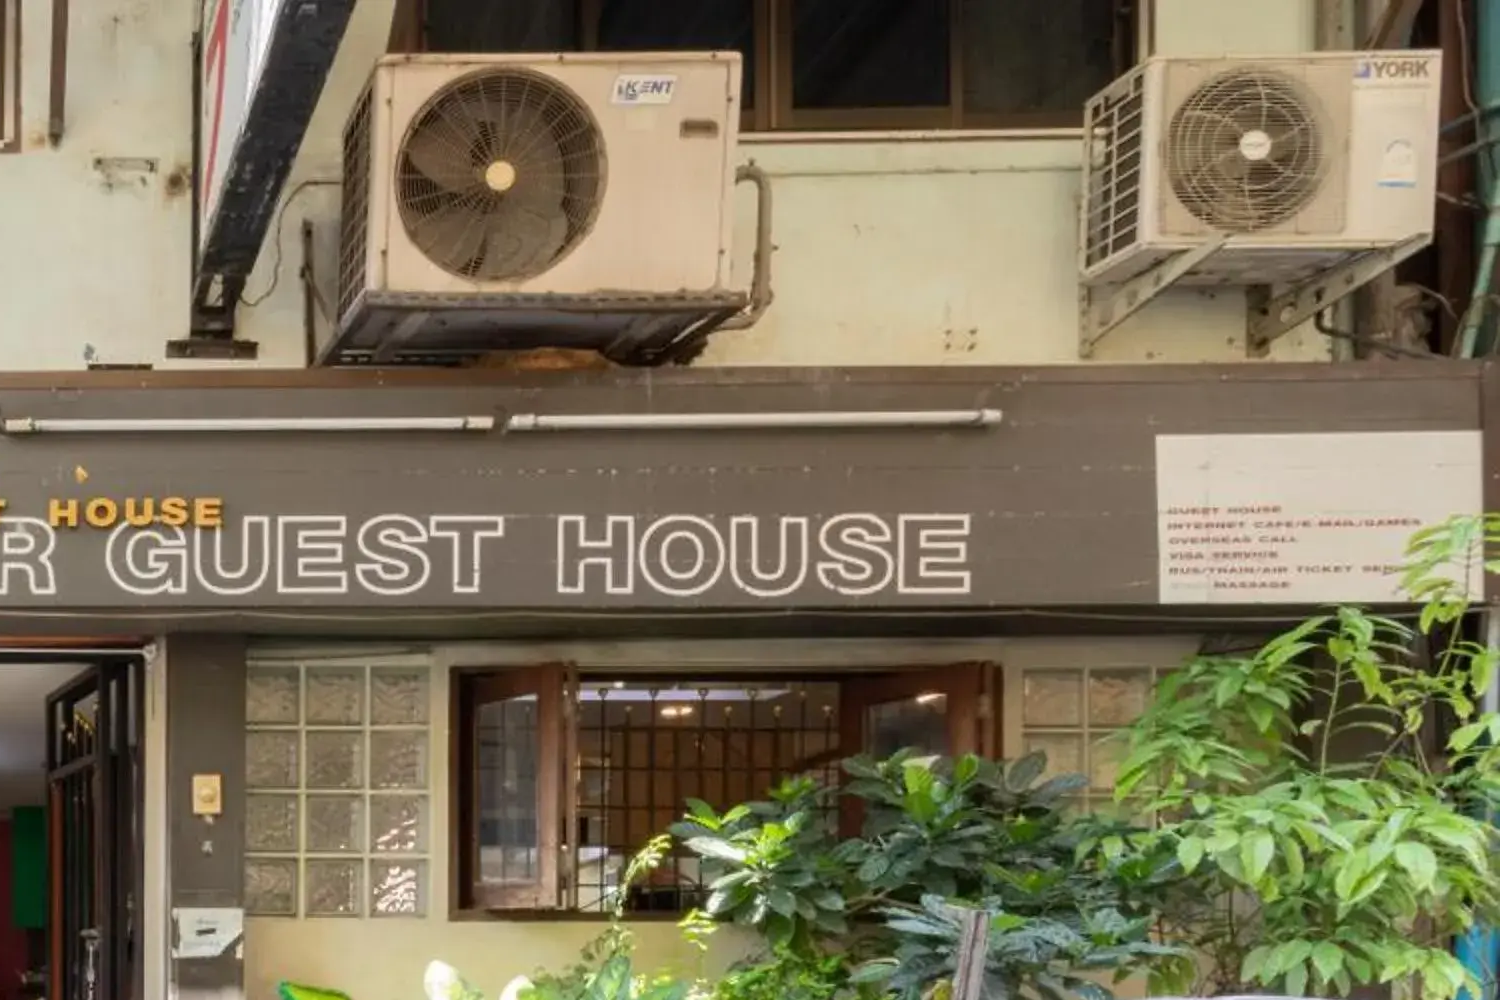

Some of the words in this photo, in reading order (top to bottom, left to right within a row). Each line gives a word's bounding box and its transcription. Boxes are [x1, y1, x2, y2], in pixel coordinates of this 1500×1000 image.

[1373, 60, 1429, 78] YORK
[49, 496, 224, 528] HOUSE
[1227, 504, 1281, 514] HOUSE
[1167, 521, 1244, 530] INTERNET
[1168, 535, 1252, 545] OVERSEAS
[1258, 534, 1297, 543] CALL
[105, 515, 505, 596] GUEST
[557, 514, 972, 596] HOUSE
[1169, 551, 1204, 560] VISA
[1297, 564, 1352, 574] TICKET
[1213, 580, 1290, 590] MASSAGE
